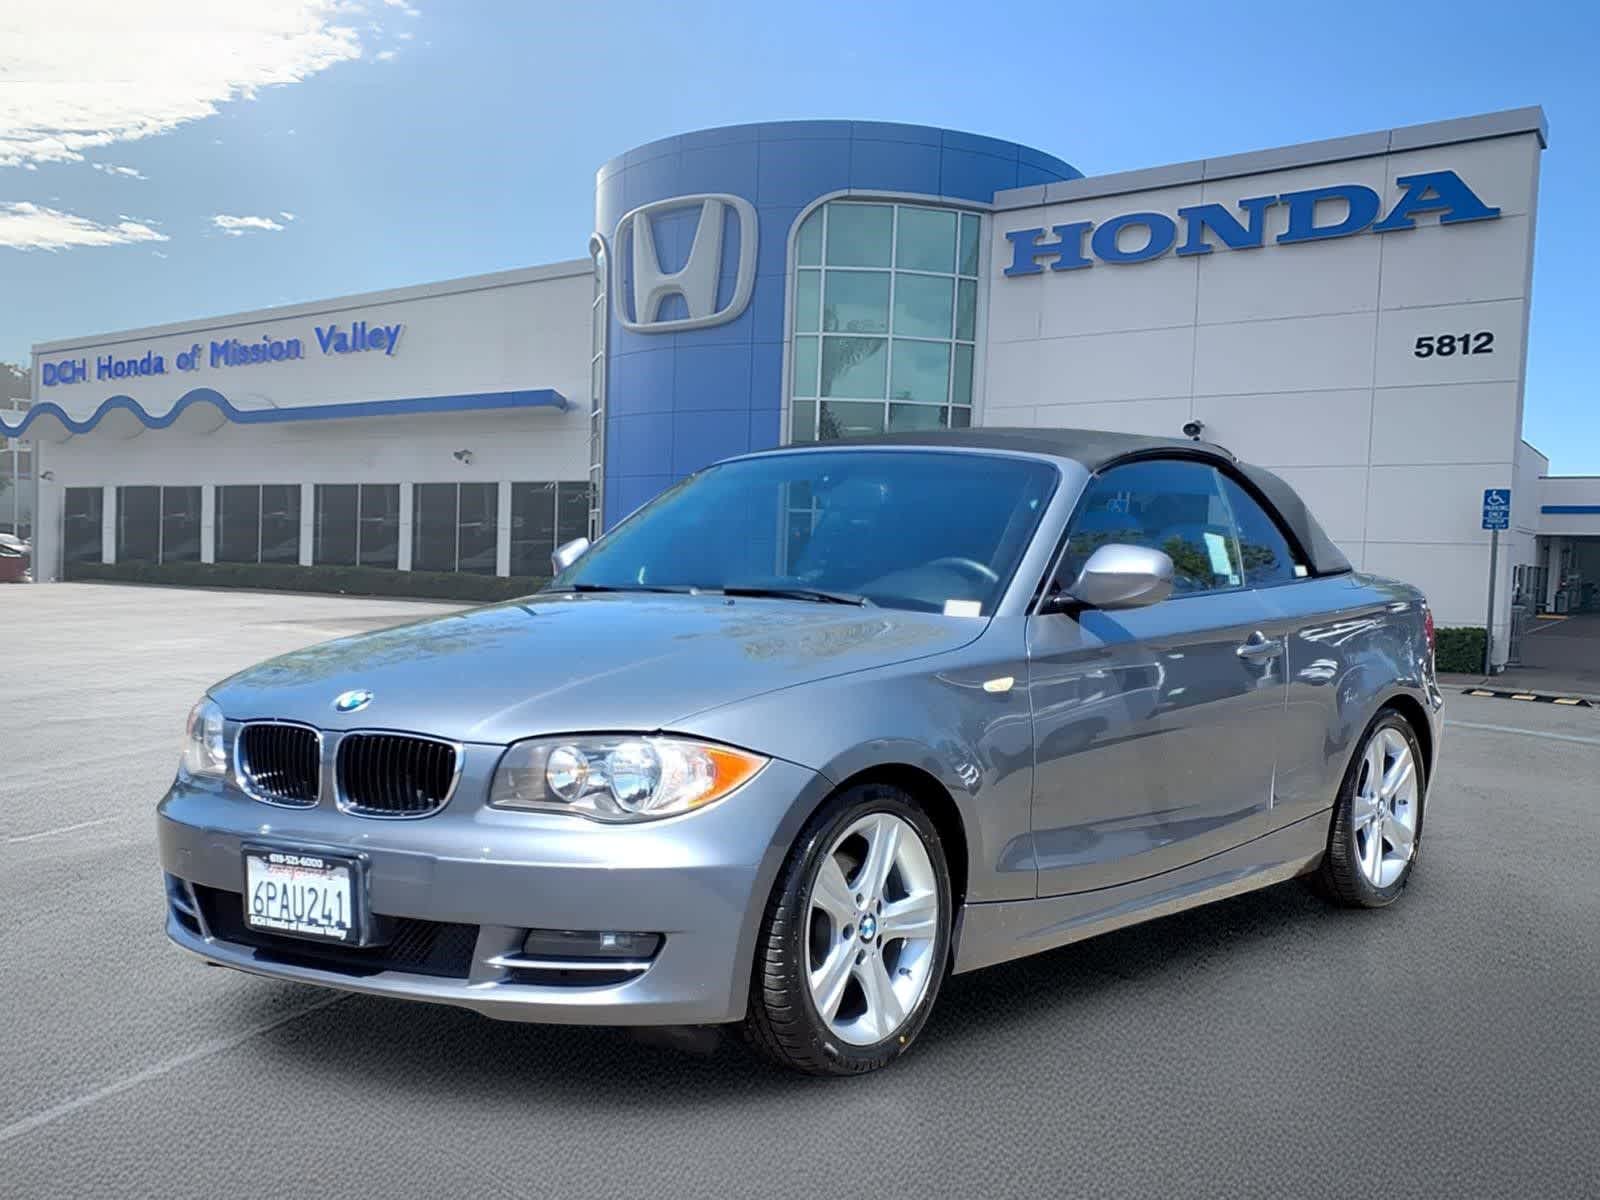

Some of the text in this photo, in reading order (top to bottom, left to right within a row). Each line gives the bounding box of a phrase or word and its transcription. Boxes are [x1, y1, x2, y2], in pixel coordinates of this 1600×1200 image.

[1004, 169, 1501, 277] HONDA
[43, 321, 402, 386] DCH Honda of Mission Valley
[1414, 332, 1495, 358] 5812
[253, 880, 343, 925] 6PAU241
